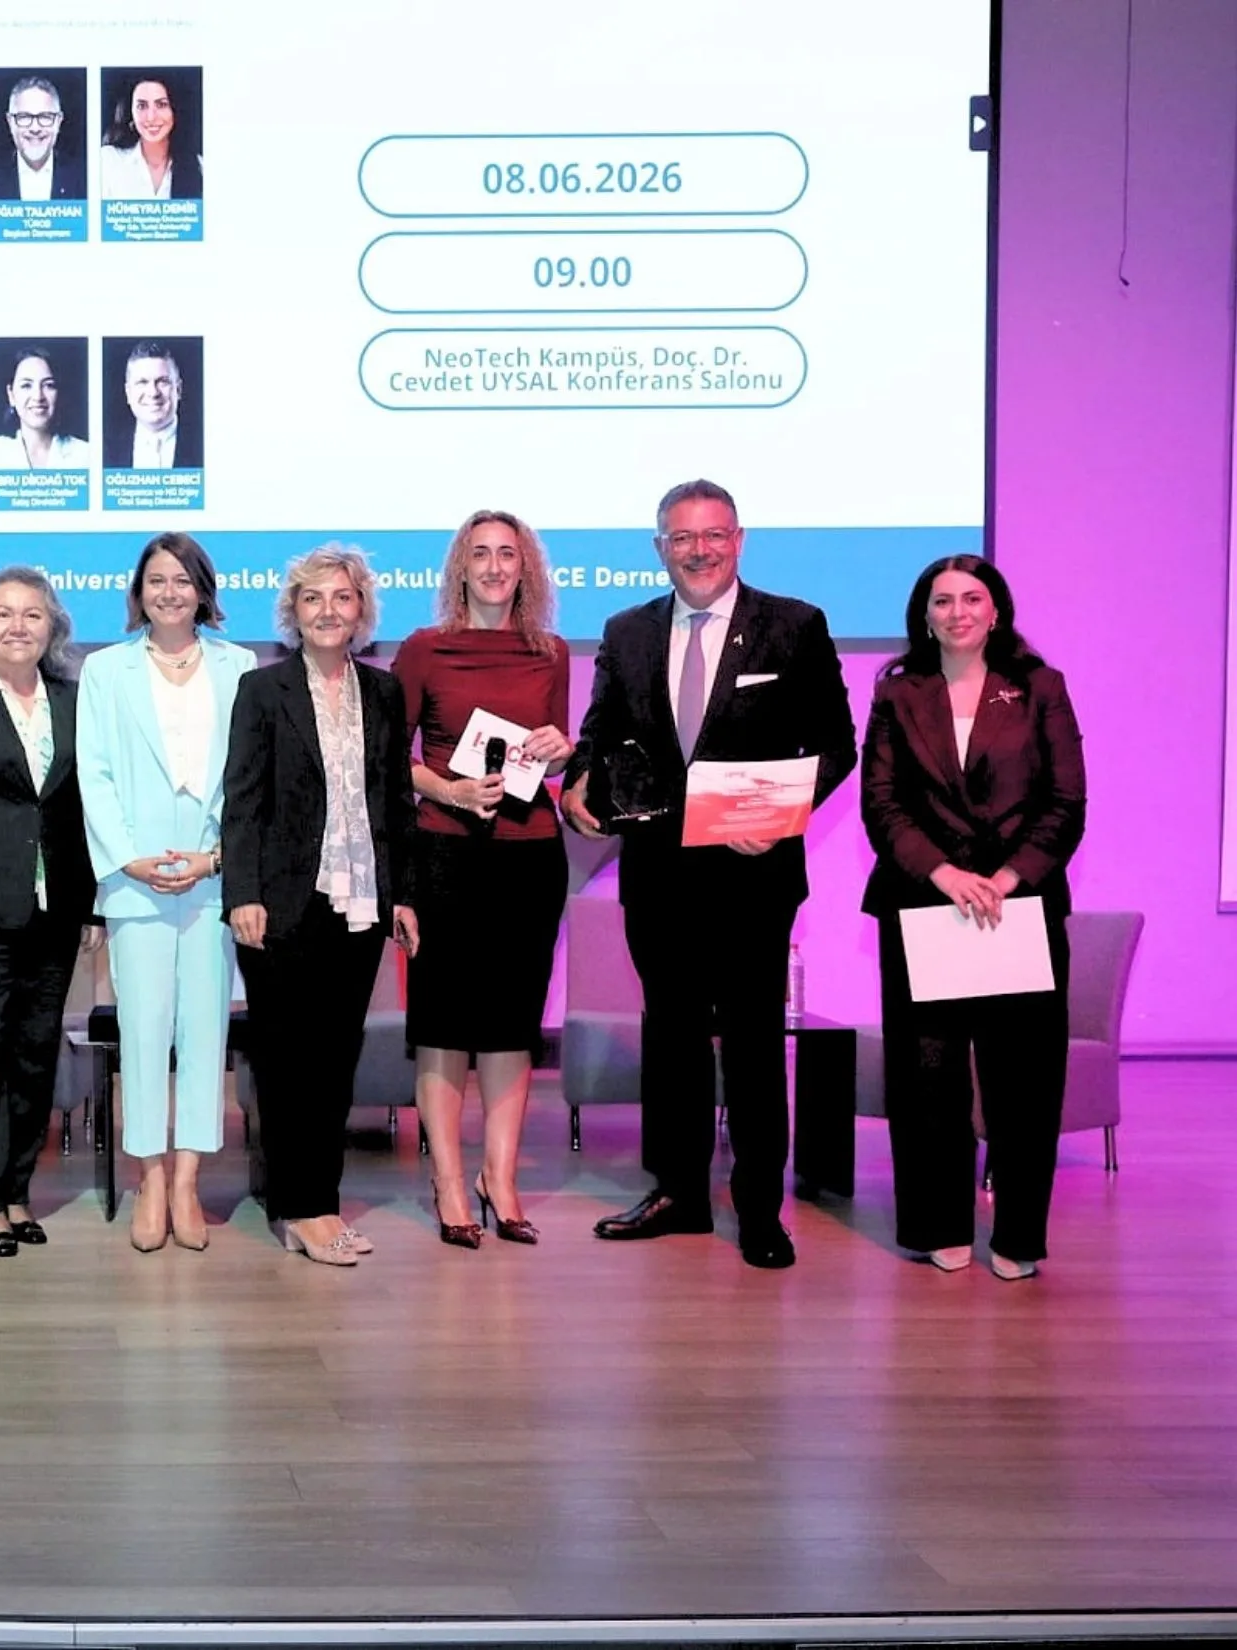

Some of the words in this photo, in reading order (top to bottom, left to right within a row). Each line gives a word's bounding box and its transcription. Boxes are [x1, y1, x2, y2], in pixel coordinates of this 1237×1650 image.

[482, 162, 683, 194] 08.06.2026
[24, 205, 82, 218] TALAYHAN
[533, 256, 633, 288] 09.00
[424, 347, 530, 369] NeoTech
[540, 346, 645, 372] Kampüs,
[653, 346, 705, 374] Doç.
[713, 346, 748, 367] Dr.
[389, 371, 473, 392] Cevdet
[482, 371, 559, 391] UYSAL
[568, 370, 693, 391] Konferans
[700, 369, 783, 390] Salonu
[63, 475, 87, 486] TOK
[215, 568, 281, 589] eslek
[595, 566, 671, 588] Derne
